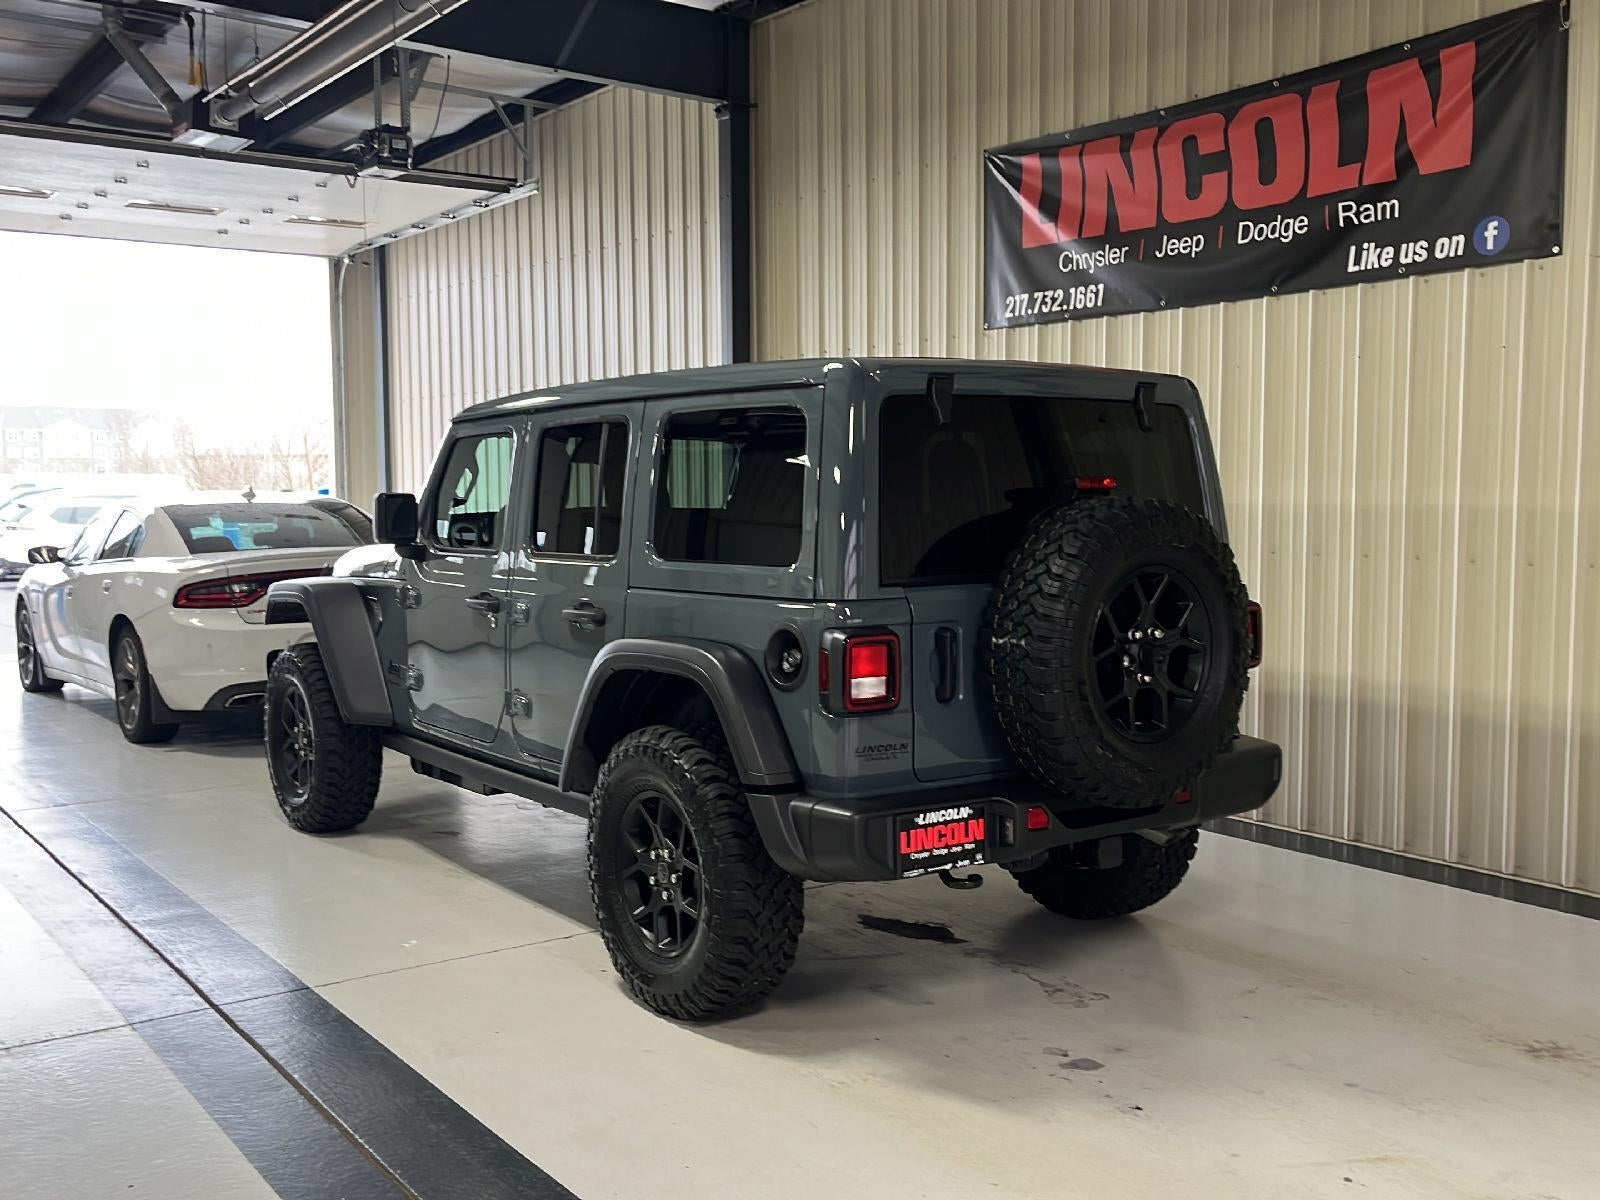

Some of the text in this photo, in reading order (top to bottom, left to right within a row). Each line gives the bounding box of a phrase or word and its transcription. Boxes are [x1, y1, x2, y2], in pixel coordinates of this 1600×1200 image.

[1020, 41, 1476, 249] LINCOLN
[1058, 199, 1400, 273] Chrysler Jeep Dodge Ram
[1347, 242, 1394, 273] Like
[1400, 241, 1428, 265] us
[1434, 233, 1466, 259] on
[1005, 283, 1105, 318] 217.732.1661
[855, 742, 909, 754] LINCOLN
[918, 806, 970, 825] LINCOLN
[900, 818, 985, 854] LINCOLN
